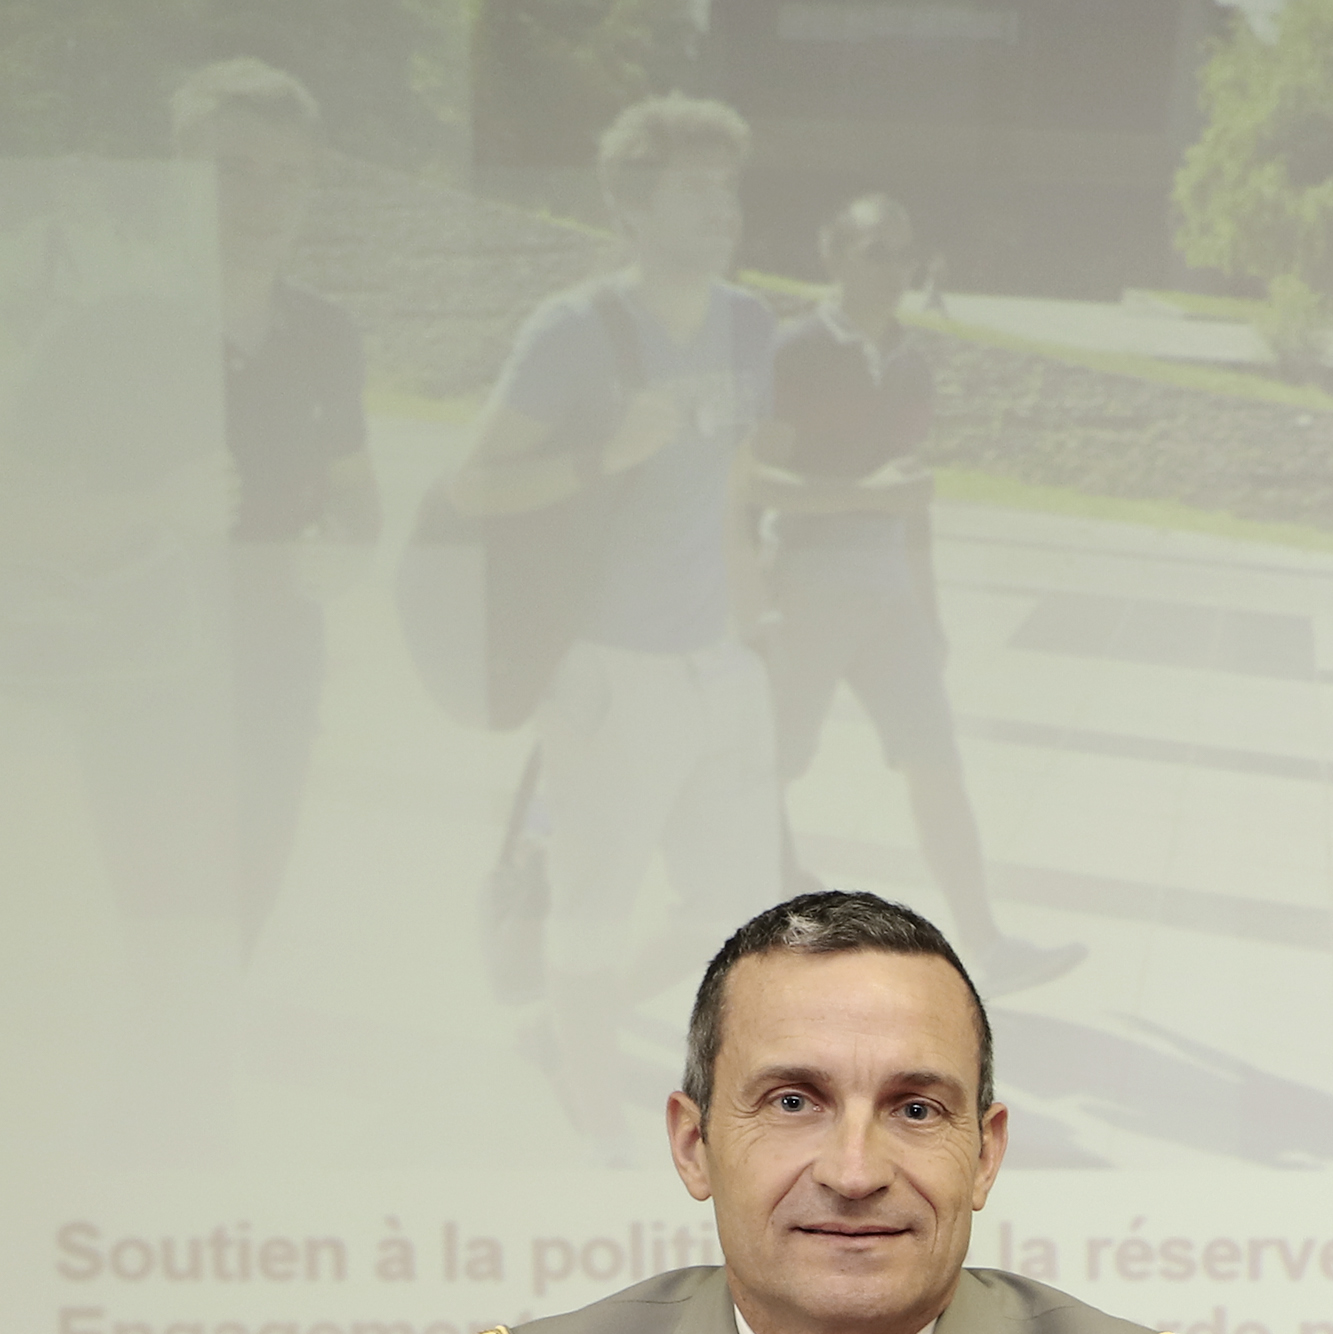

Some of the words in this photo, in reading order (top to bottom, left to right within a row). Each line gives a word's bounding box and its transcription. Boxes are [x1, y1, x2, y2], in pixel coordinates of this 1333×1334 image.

[55, 1219, 345, 1283] Soutien
[374, 1215, 417, 1283] à
[441, 1220, 506, 1283] la
[530, 1218, 717, 1297] politi
[997, 1219, 1058, 1281] la
